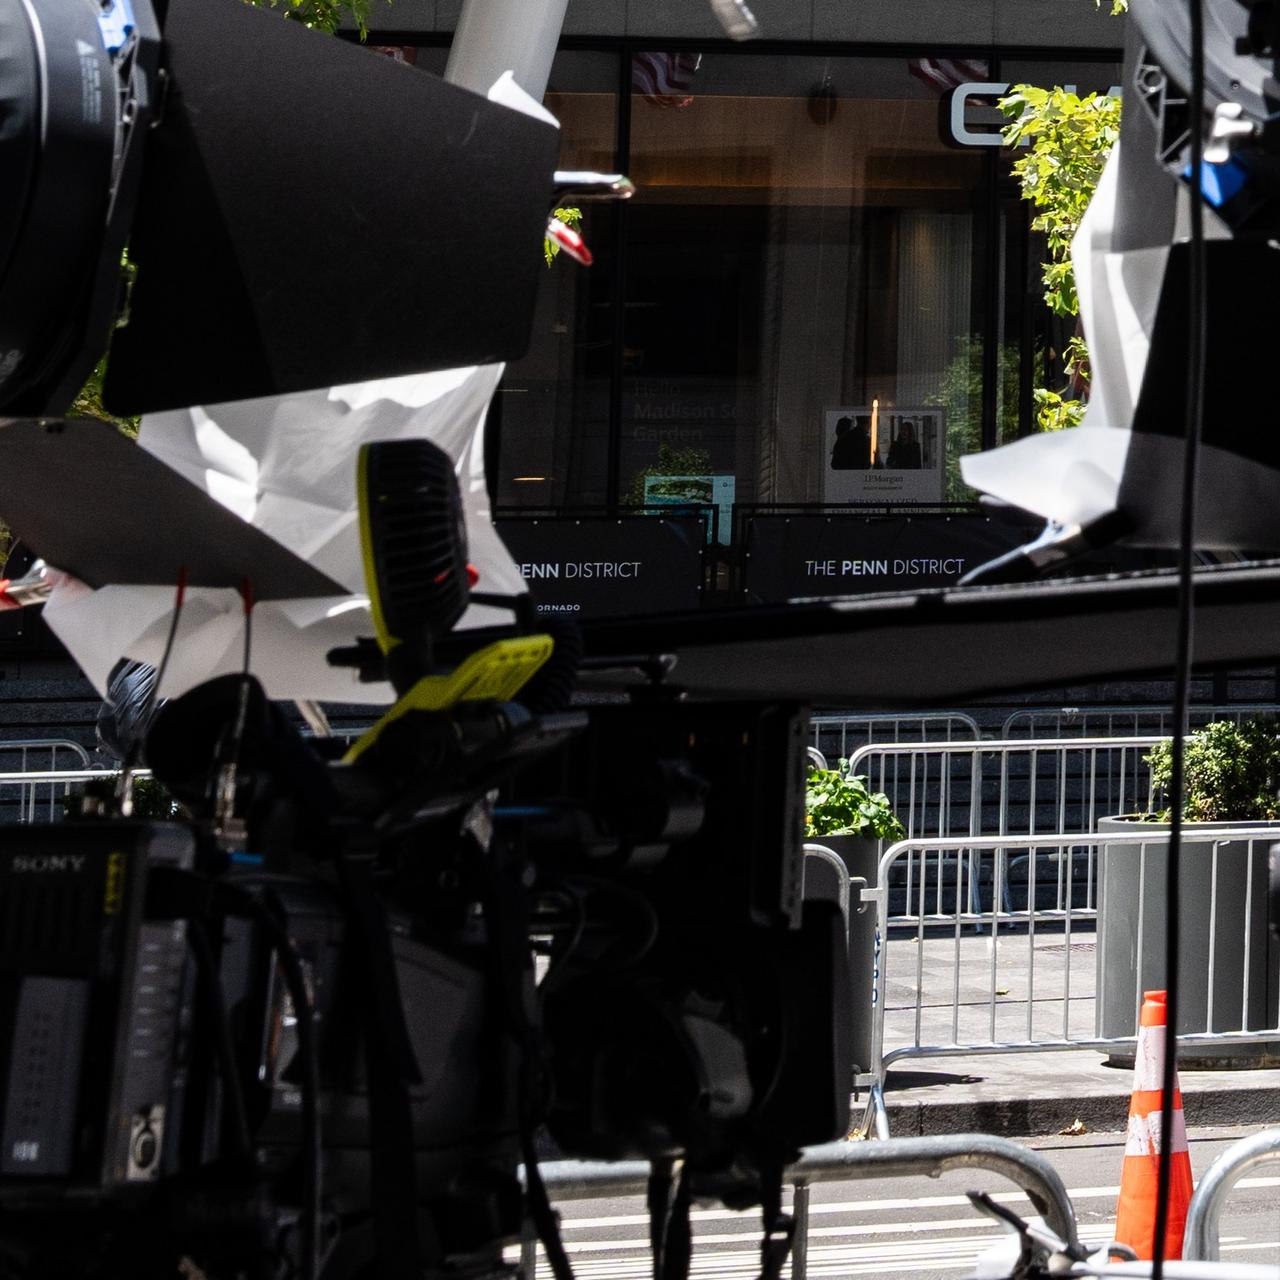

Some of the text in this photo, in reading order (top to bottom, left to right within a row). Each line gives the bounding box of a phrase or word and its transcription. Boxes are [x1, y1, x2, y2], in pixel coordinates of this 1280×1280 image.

[564, 561, 643, 579] DISTRICT
[804, 558, 966, 576] THE PENN DISTRICT
[535, 604, 582, 613] ORNADO
